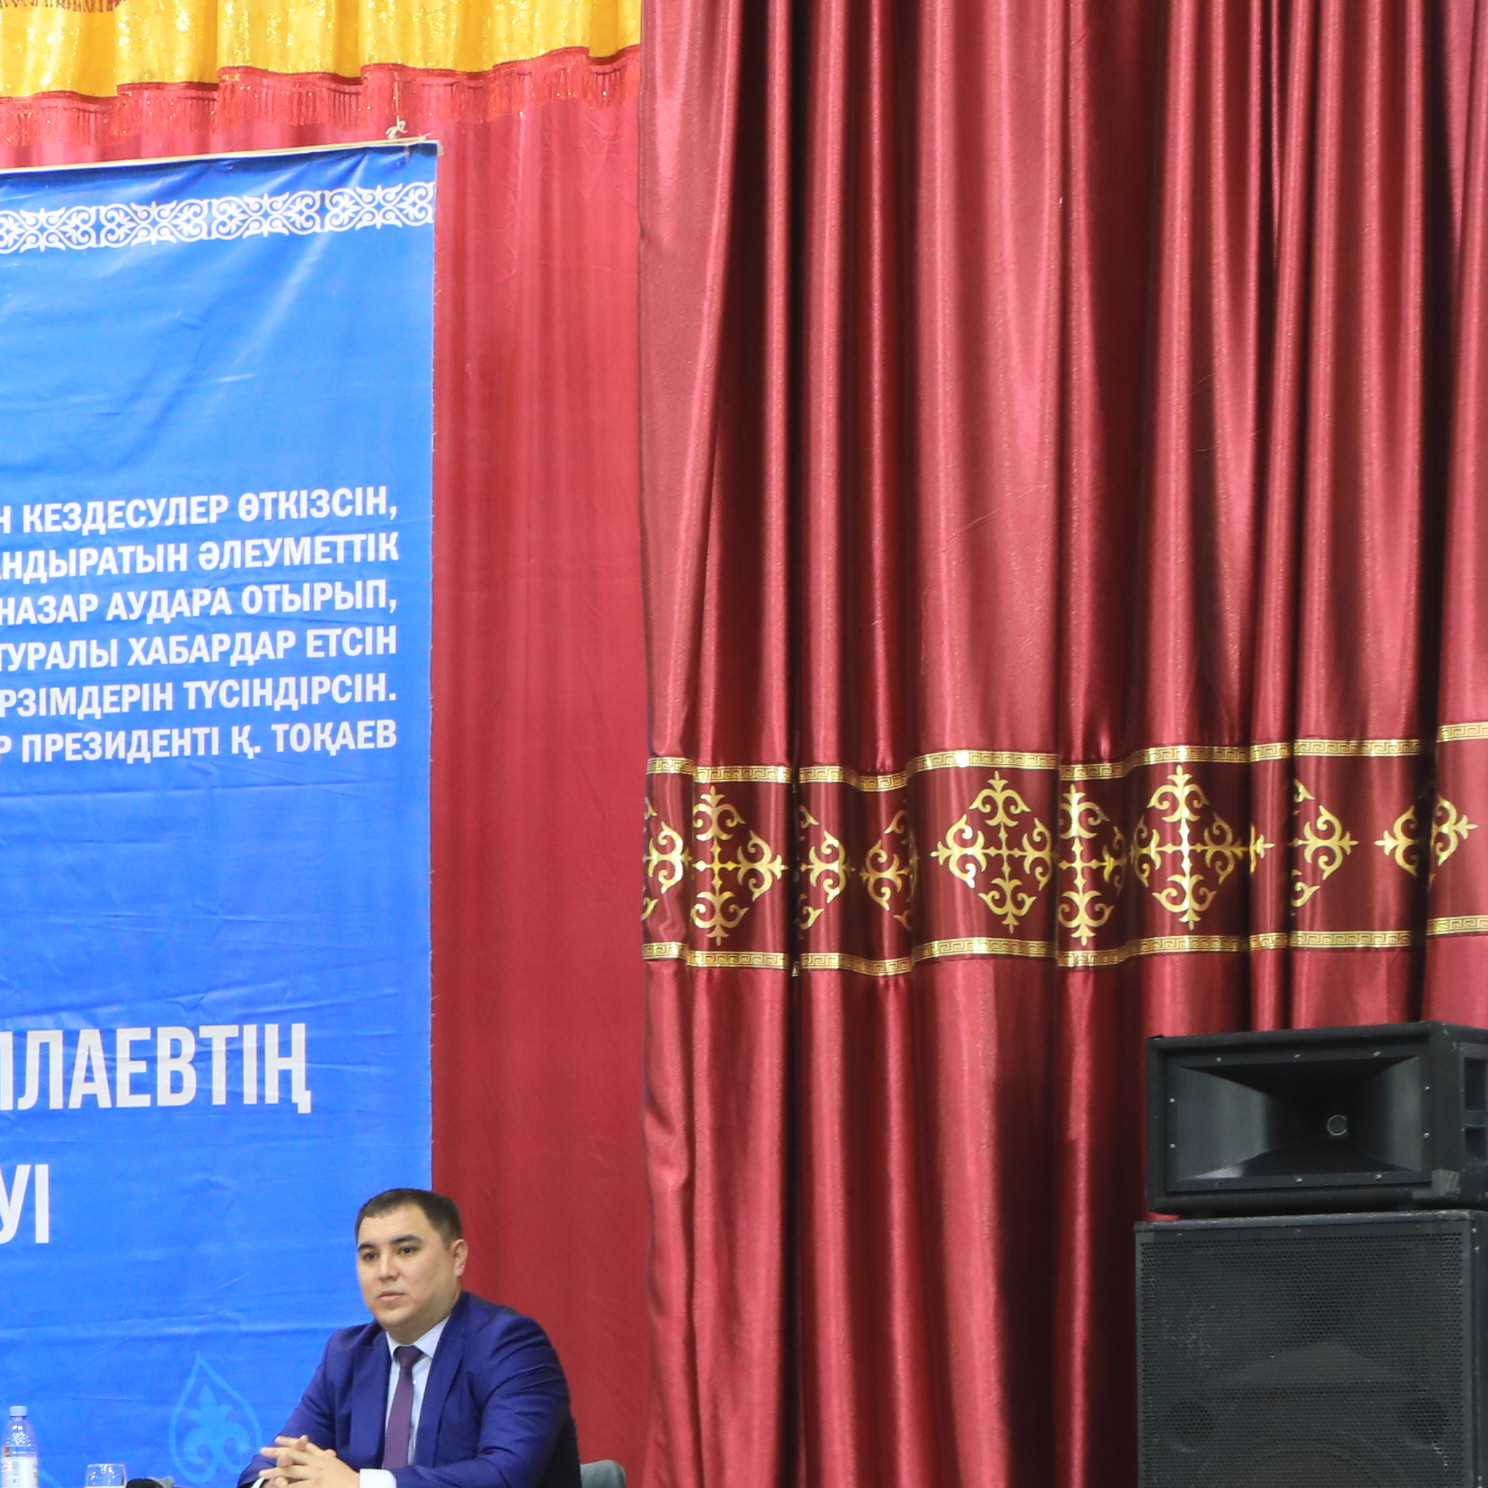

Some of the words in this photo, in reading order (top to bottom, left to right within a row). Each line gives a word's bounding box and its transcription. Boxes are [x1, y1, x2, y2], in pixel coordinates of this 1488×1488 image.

[22, 495, 230, 536] КЕЗДЕСУЛЕР
[237, 486, 398, 522] ӨТКІЗСІН,
[198, 532, 399, 571] ӘЛЕУМЕТТІК
[105, 587, 233, 625] АУДАРА
[241, 579, 397, 615] ОТЫРЫП,
[127, 630, 297, 667] ХАБАРДАР
[306, 626, 397, 658] ЕТСІН
[182, 673, 397, 712] ТҮСІНДІРСІН.
[22, 727, 220, 764] ПРЕЗИДЕНТІ
[231, 725, 261, 760] Қ.
[270, 719, 397, 756] ТОҚАЕВ
